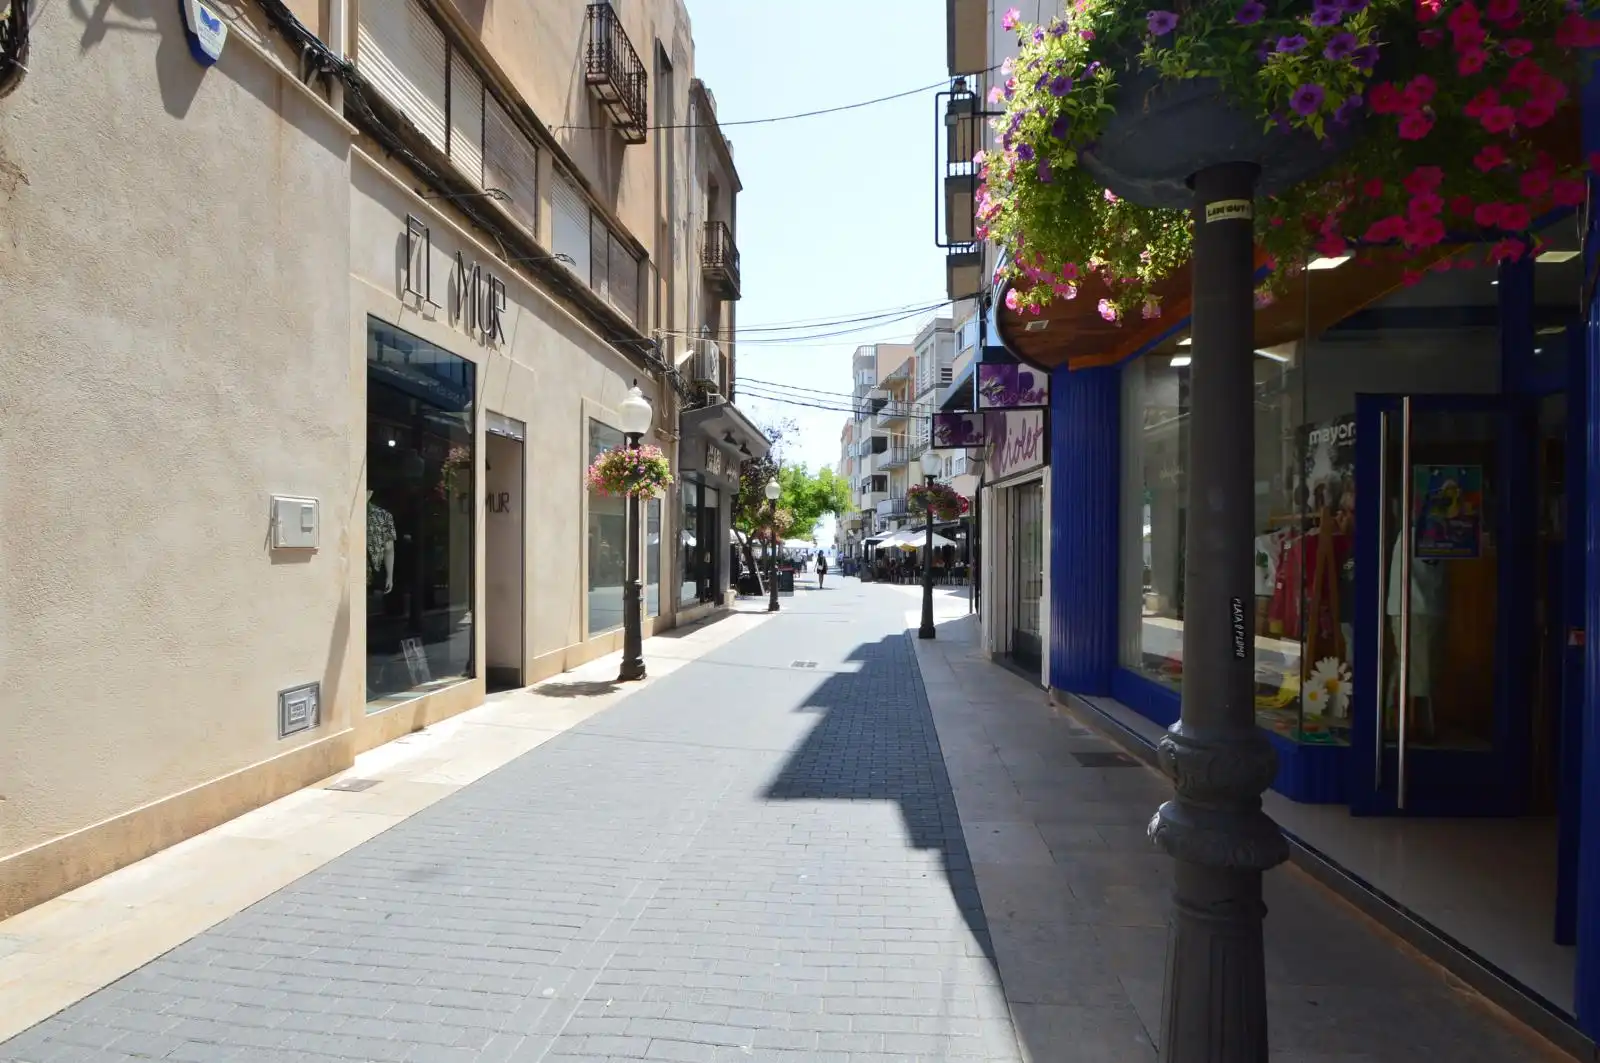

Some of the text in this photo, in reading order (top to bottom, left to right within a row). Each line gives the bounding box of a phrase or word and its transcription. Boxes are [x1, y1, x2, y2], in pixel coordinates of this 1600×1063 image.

[455, 250, 506, 345] MUR
[998, 414, 1044, 474] Violet
[1308, 421, 1357, 446] mayor
[1233, 598, 1244, 623] PLATA
[1235, 631, 1245, 658] PLOMO
